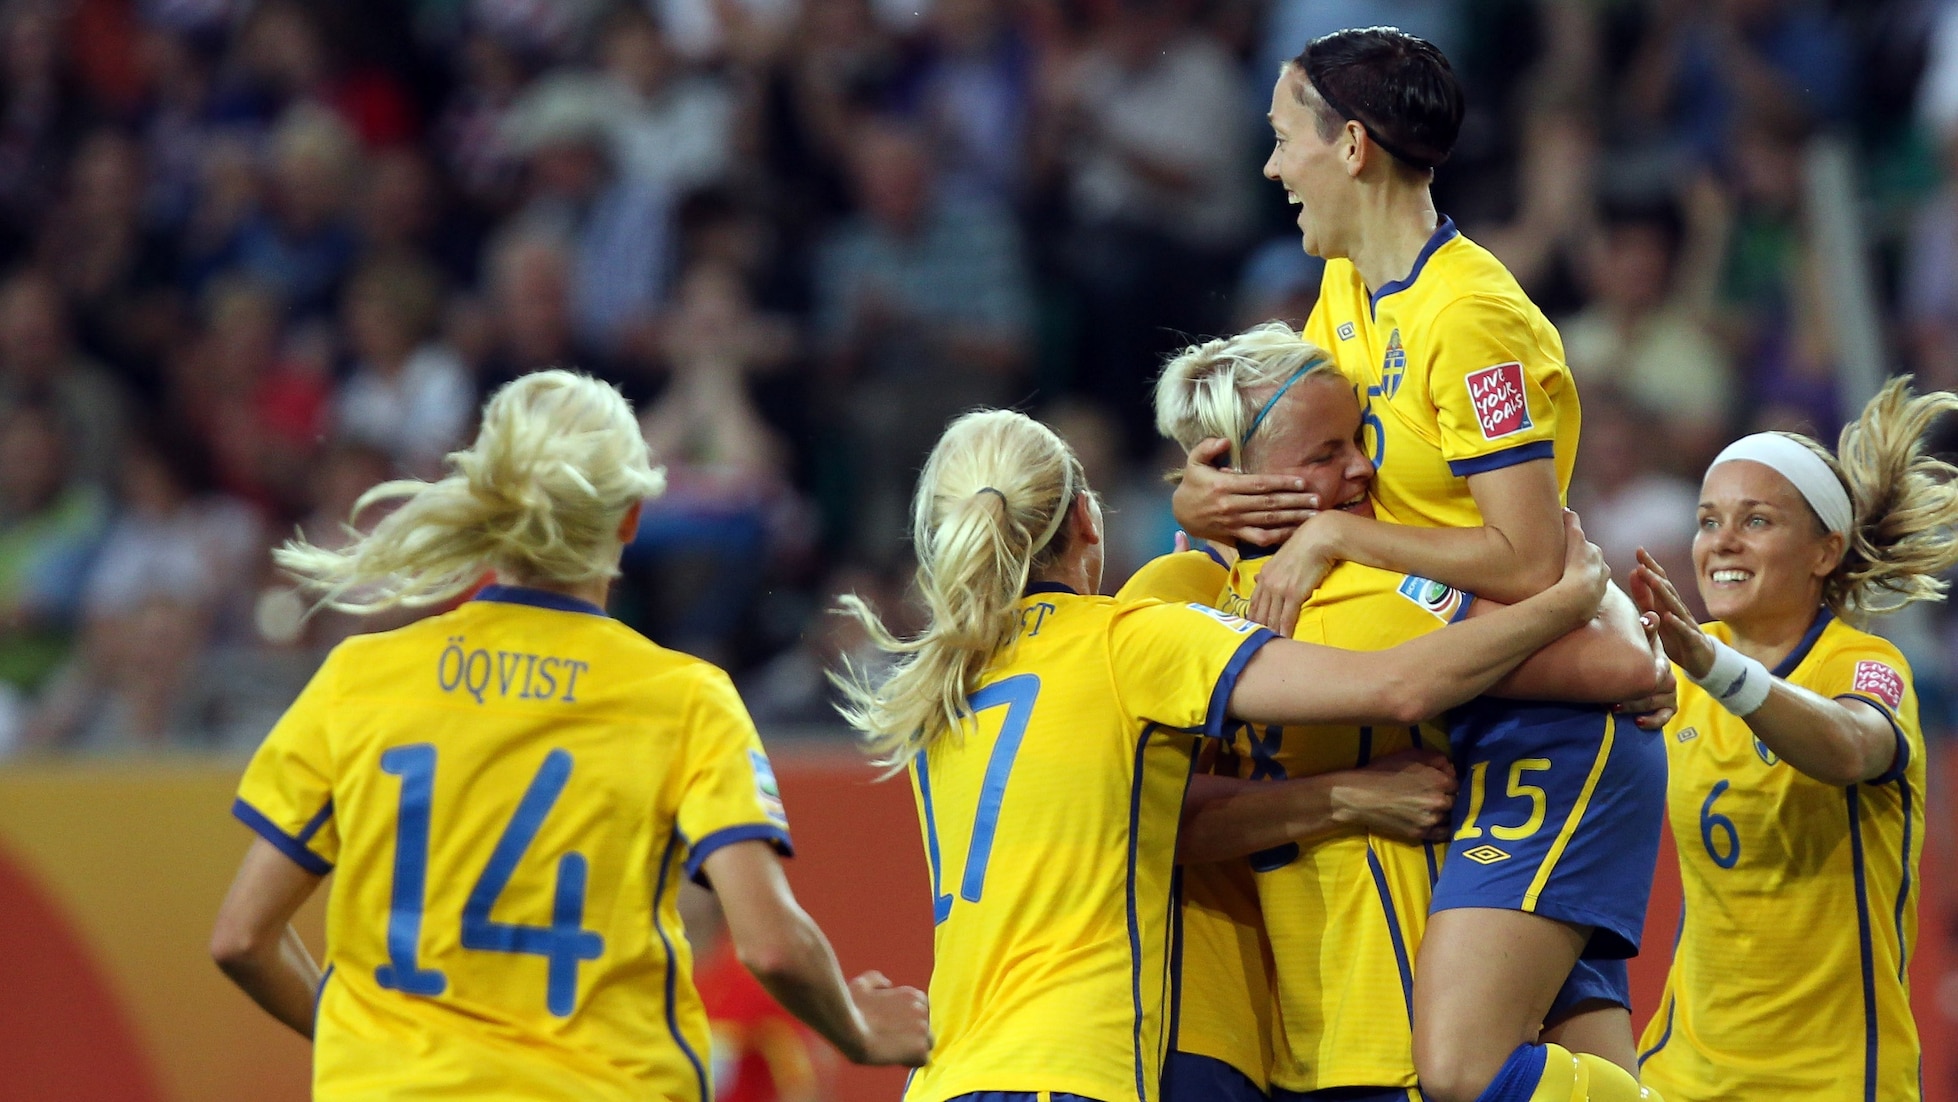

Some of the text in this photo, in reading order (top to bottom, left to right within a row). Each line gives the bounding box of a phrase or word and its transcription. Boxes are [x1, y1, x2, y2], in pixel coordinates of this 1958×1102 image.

[1473, 368, 1506, 398] LIVE
[1477, 381, 1518, 415] YOUR
[1483, 393, 1524, 432] GOALS
[438, 635, 589, 705] ÖQVIST
[1453, 758, 1552, 841] 15
[1700, 779, 1741, 869] 6
[375, 742, 605, 1017] 14
